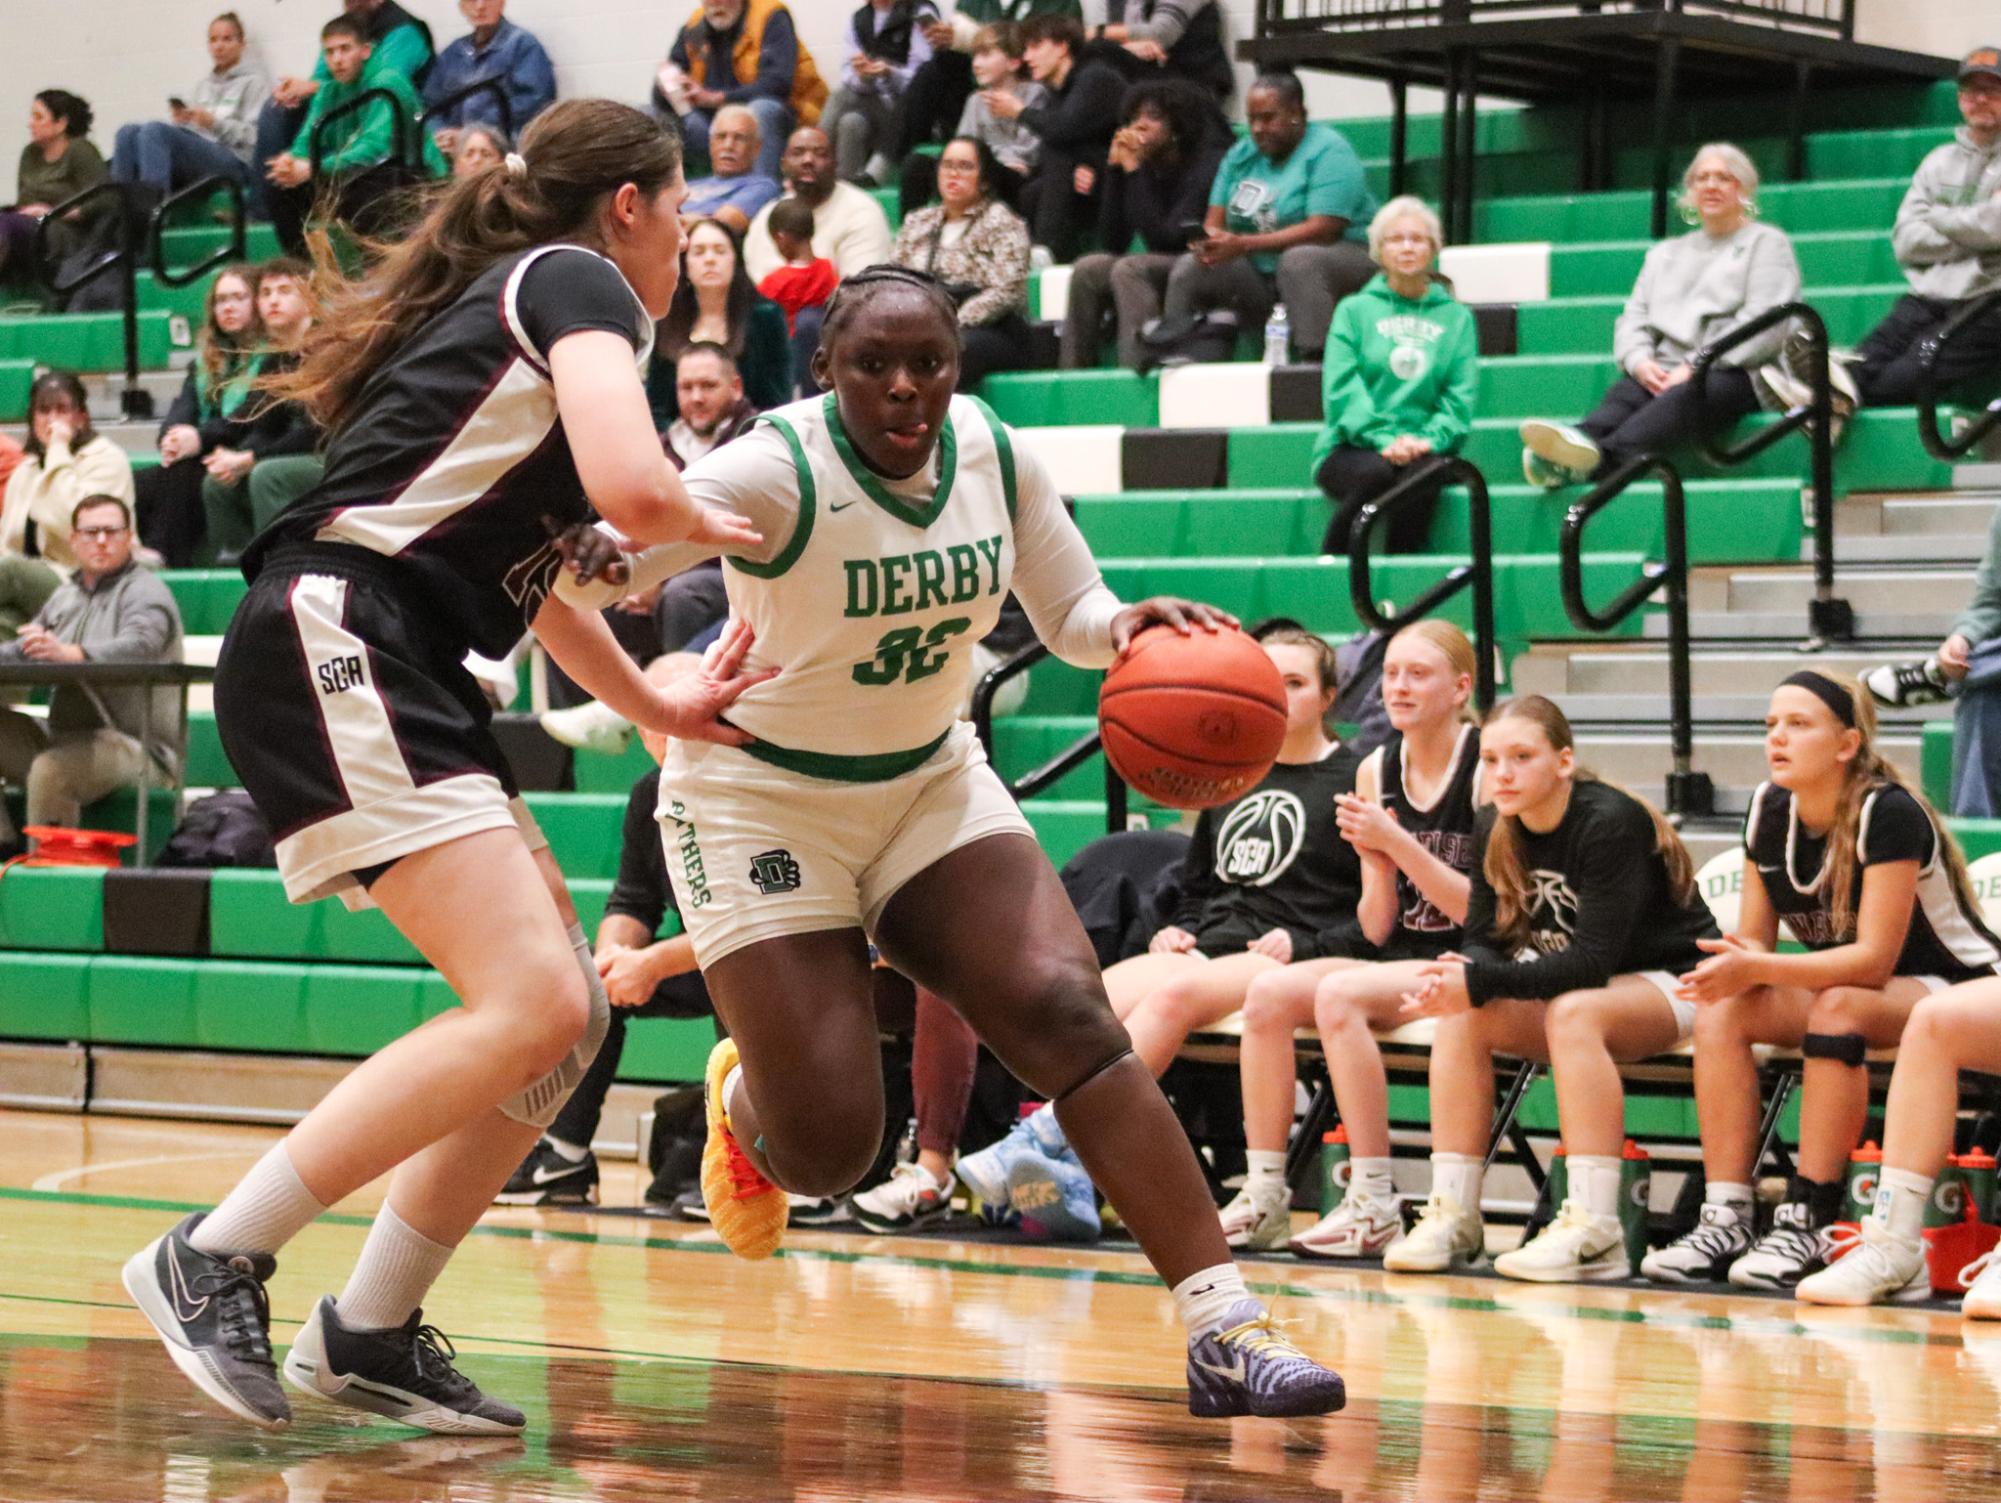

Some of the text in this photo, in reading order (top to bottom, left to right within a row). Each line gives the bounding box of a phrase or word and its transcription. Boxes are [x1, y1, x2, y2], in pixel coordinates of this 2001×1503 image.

[843, 534, 1002, 618] DERBY
[318, 656, 365, 695] SCA
[1227, 838, 1271, 875] SCA
